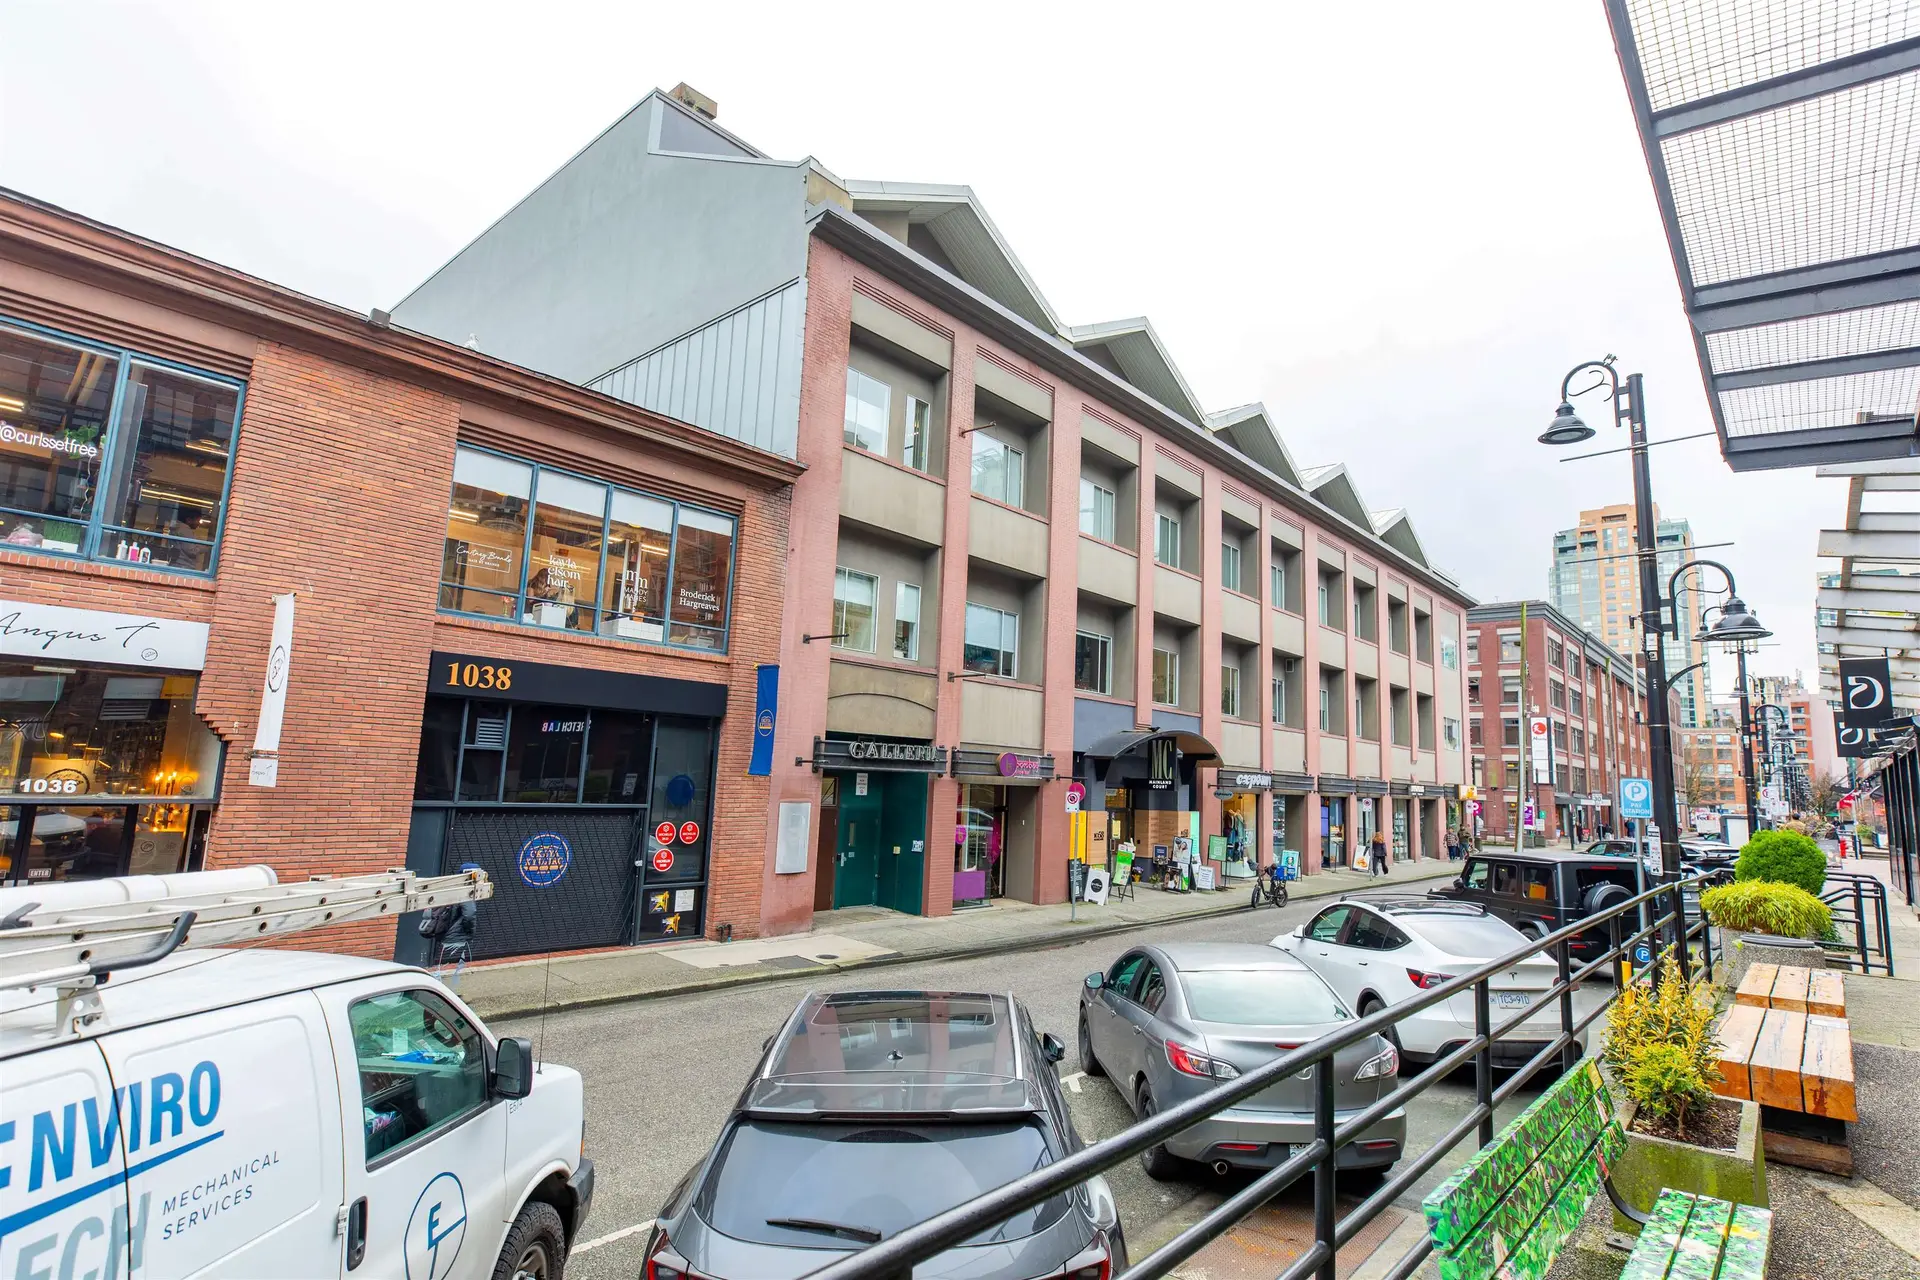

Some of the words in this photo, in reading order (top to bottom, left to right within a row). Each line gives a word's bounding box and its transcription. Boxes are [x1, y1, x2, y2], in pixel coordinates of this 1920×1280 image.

[0, 425, 98, 457] @curlssetfree
[549, 554, 578, 570] kayla
[547, 567, 581, 581] elsom
[547, 574, 569, 589] hair
[680, 588, 717, 603] Broderick
[679, 597, 721, 612] Hargreaves
[0, 612, 107, 650] Angus
[115, 622, 160, 648] T
[446, 661, 513, 691] 1038
[849, 741, 940, 762] GALLERIA
[1151, 739, 1173, 780] MC
[19, 778, 78, 793] 1036
[1631, 785, 1642, 799] P
[30, 870, 50, 878] ENTER
[1641, 951, 1649, 960] P
[162, 1151, 280, 1216] MECHANICAL
[162, 1184, 254, 1241] SERVICES
